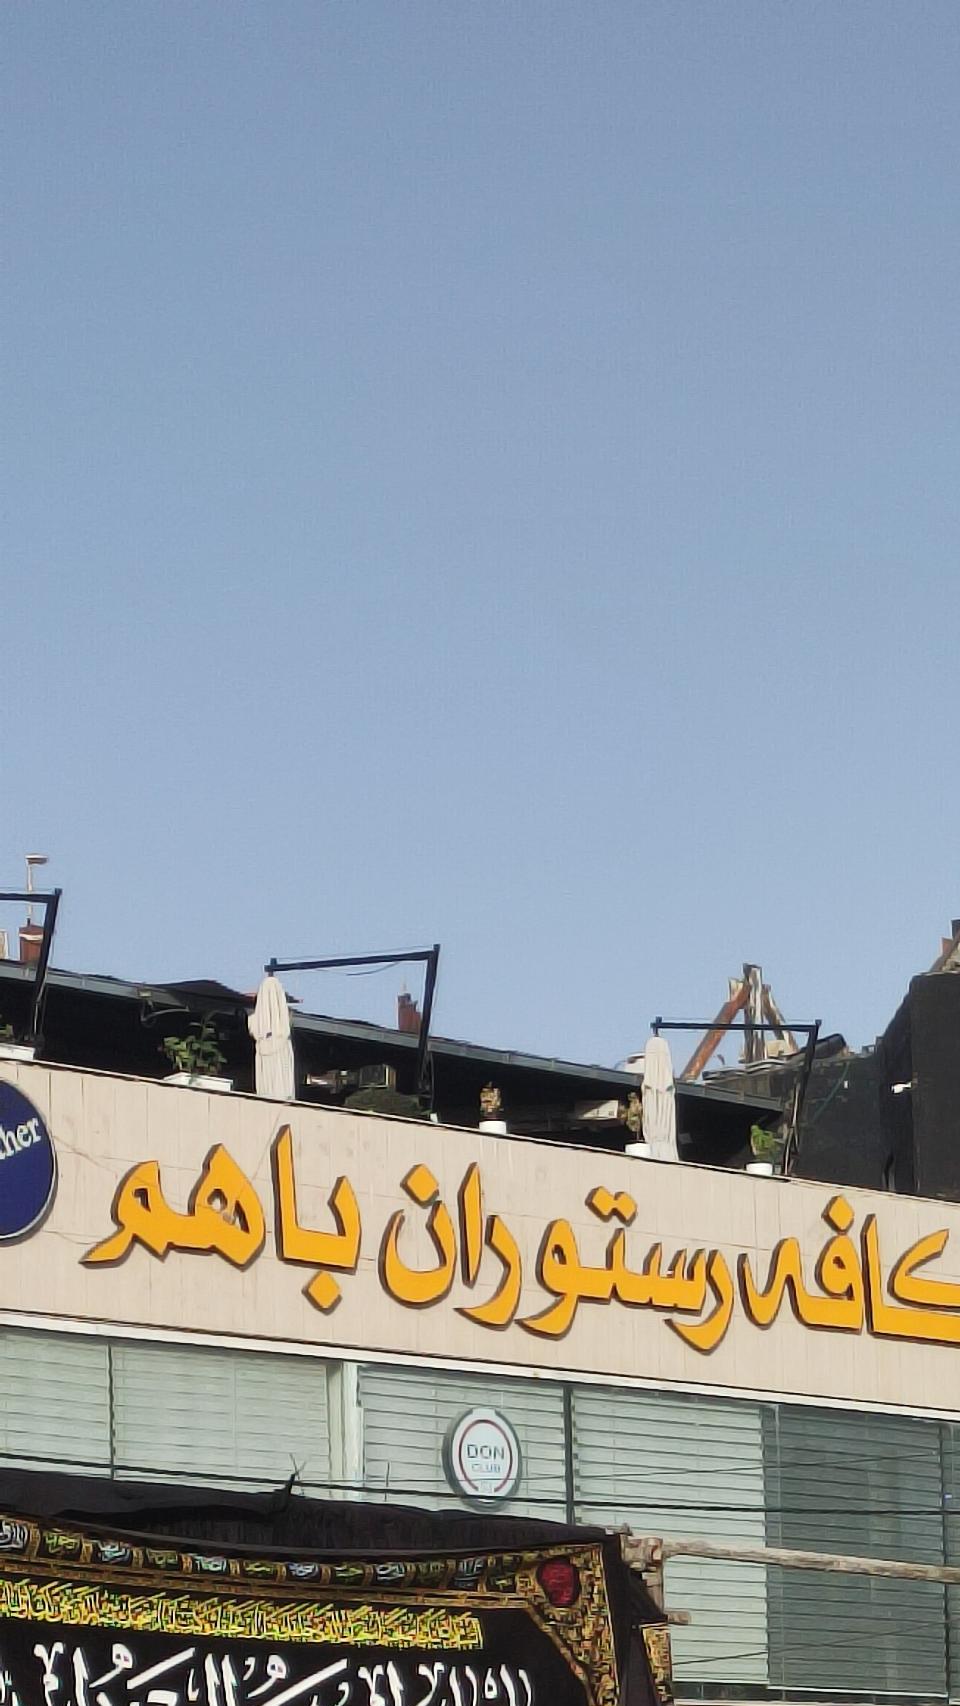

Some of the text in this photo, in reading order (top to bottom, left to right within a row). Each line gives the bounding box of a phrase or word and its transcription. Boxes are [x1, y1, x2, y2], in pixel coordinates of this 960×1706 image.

[0, 1116, 41, 1159] her
[379, 1161, 735, 1354] رستوران
[466, 1444, 505, 1461] DON
